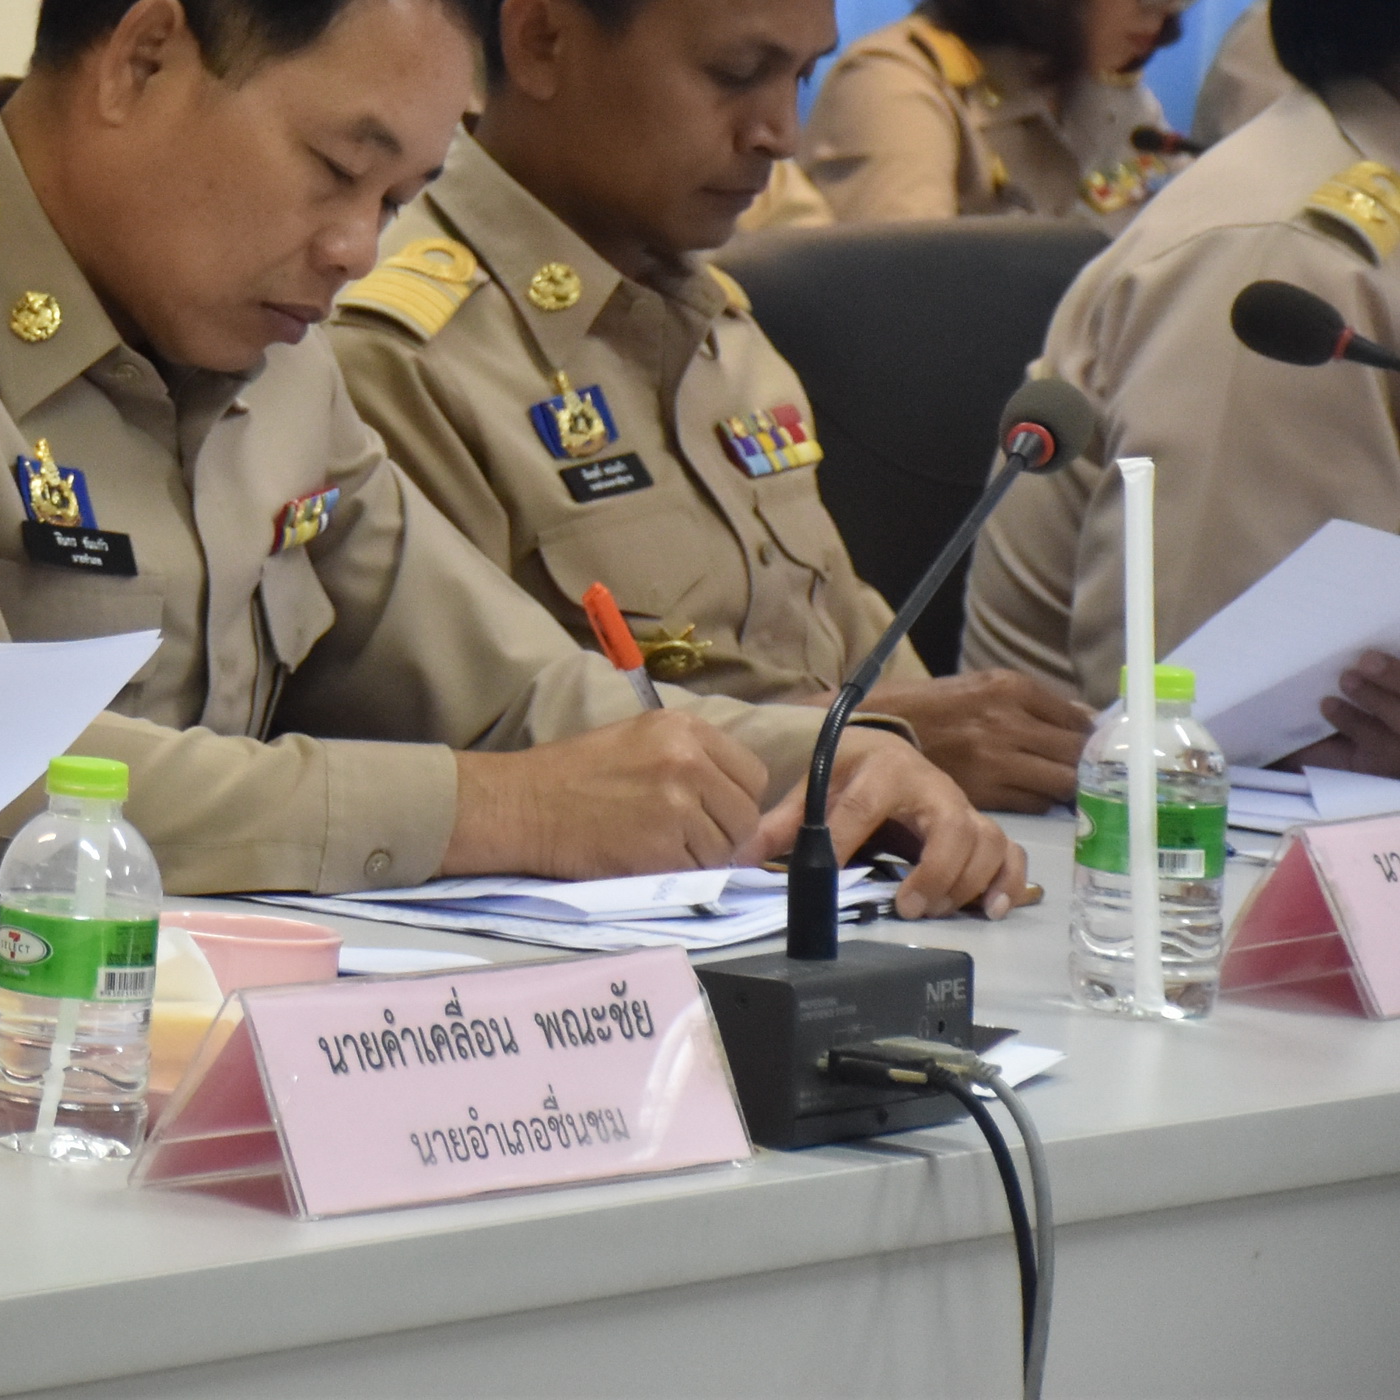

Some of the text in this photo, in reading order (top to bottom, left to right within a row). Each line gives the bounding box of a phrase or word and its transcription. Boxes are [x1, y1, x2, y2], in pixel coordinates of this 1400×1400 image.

[0, 938, 31, 954] SELECT
[926, 977, 967, 1002] NPE
[318, 981, 656, 1074] นายคำเคลื่อน พณะชัย
[410, 1085, 630, 1166] นายอำเภอชื่นชม
